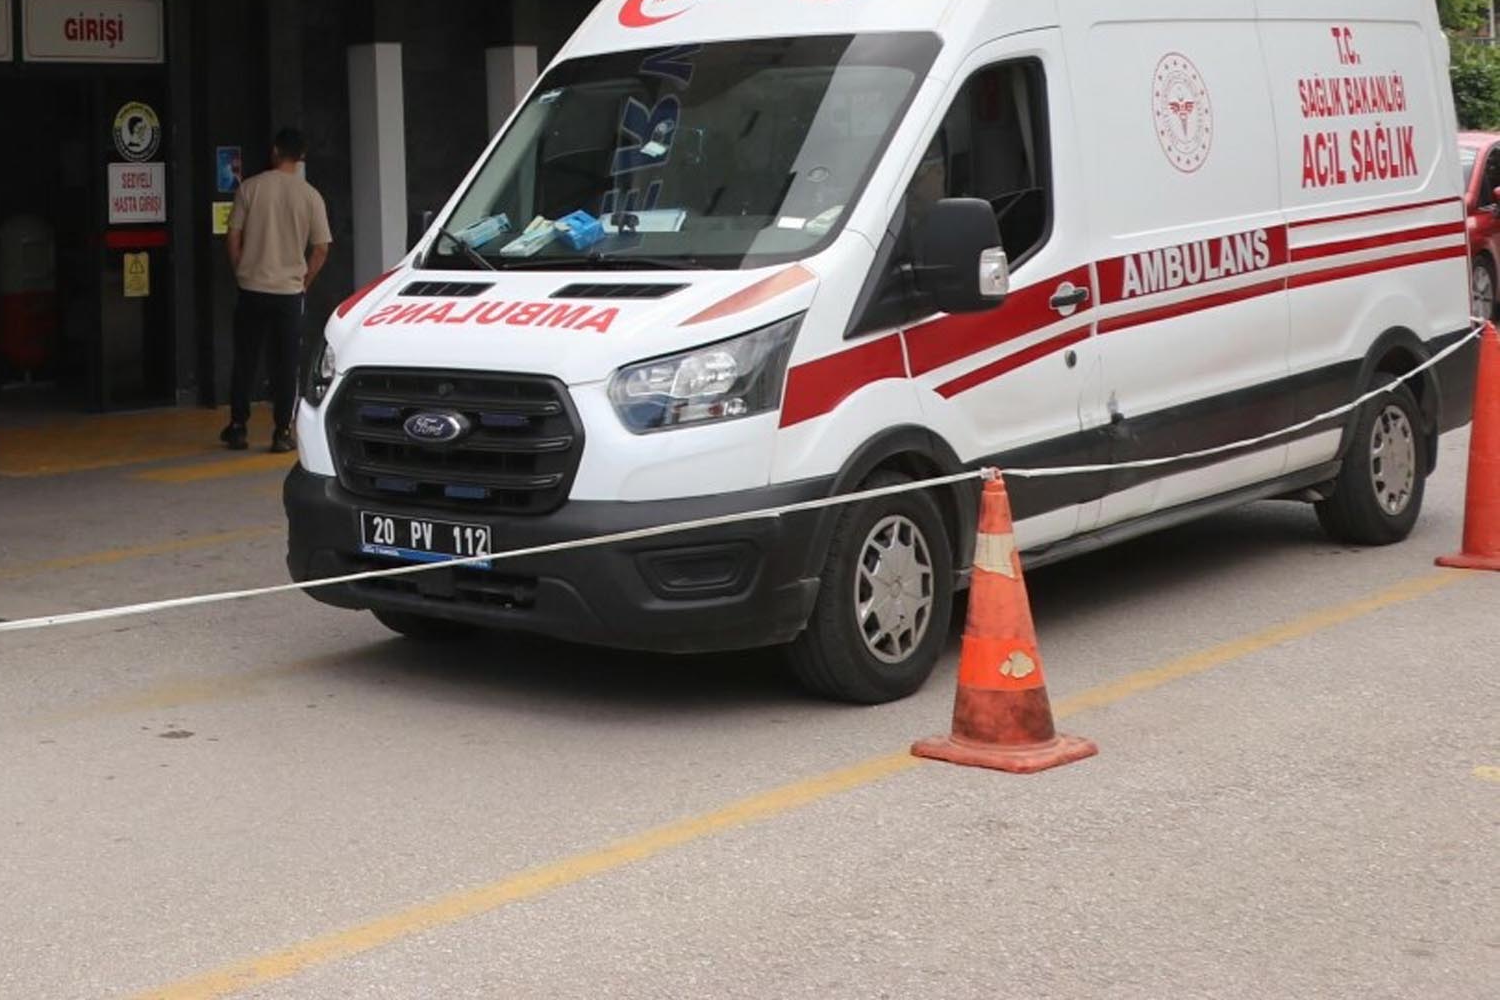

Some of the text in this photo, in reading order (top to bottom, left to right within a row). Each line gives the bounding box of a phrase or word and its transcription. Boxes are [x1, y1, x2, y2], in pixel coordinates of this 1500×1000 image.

[64, 12, 124, 48] GİRİŞİ
[1331, 27, 1360, 65] T.C.
[1299, 70, 1406, 118] SAĞLIK BAKANLIĞI
[1302, 121, 1418, 188] ACİL SAĞLIK
[1122, 229, 1270, 298] AMBULANS
[373, 516, 487, 556] 20 PV 112
